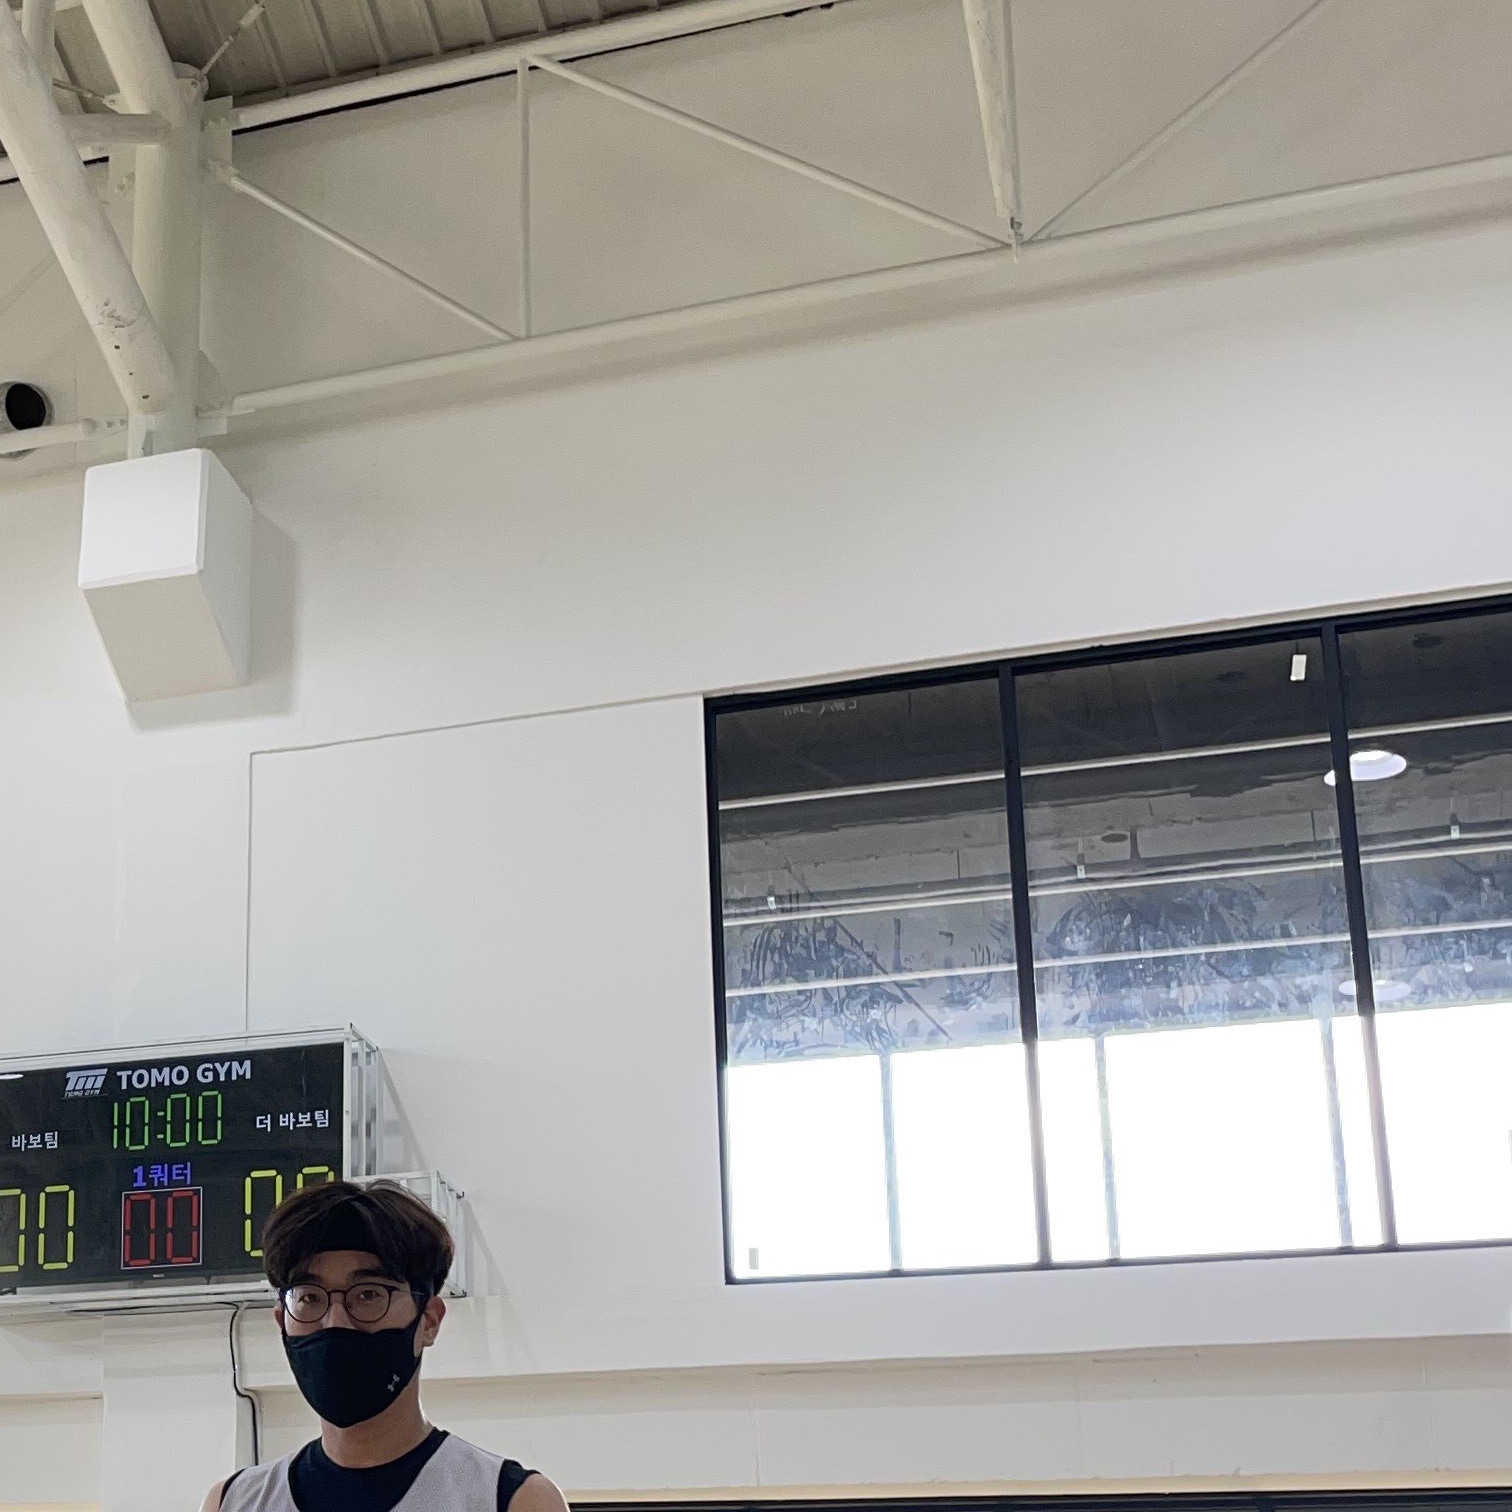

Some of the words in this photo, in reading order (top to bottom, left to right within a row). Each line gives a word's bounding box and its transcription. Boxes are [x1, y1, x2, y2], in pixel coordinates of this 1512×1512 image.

[116, 1065, 189, 1090] TOMO
[196, 1059, 252, 1083] GYM
[113, 1090, 222, 1150] 10:00
[256, 1114, 271, 1132] 더
[279, 1109, 329, 1131] 바보팀
[11, 1131, 58, 1152] 바보팀
[133, 1162, 191, 1187] 1쿼터
[244, 1166, 335, 1258] 0
[124, 1191, 199, 1266] 00
